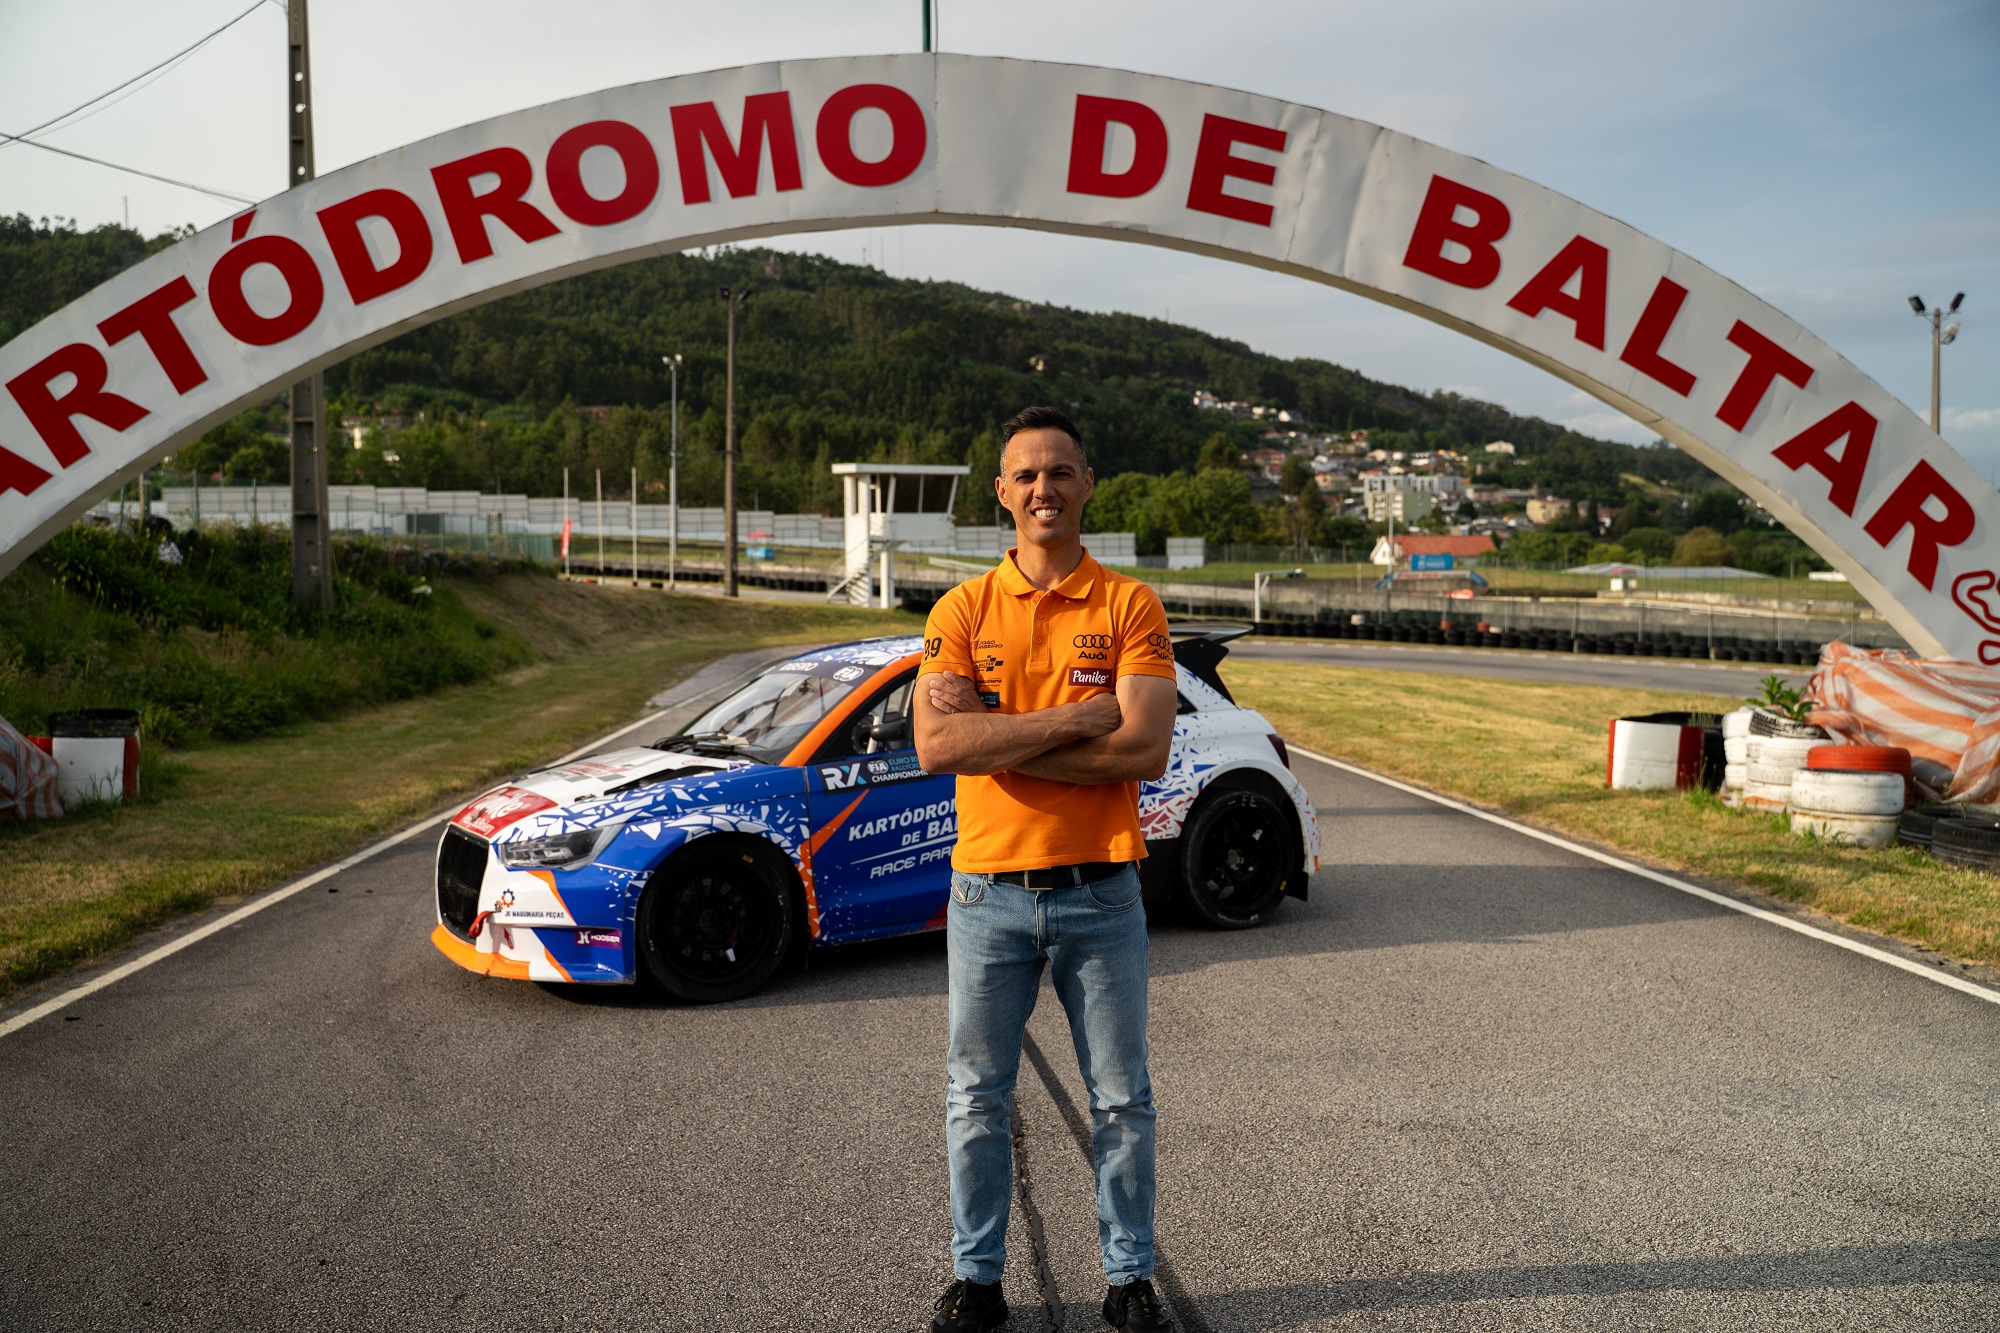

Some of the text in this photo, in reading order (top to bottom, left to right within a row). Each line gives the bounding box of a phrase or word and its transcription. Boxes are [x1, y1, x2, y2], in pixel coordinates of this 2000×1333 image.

[1067, 95, 1286, 226] DE
[1404, 176, 1970, 591] BALTAR
[1078, 651, 1107, 660] Audi
[867, 760, 888, 772] FIA
[888, 757, 910, 766] EURO
[891, 763, 920, 772] RALLYCRO
[821, 763, 867, 790] RX
[848, 798, 957, 841] KARTÓDRO
[901, 816, 958, 846] DE BA
[869, 845, 954, 879] RACE PAR
[545, 911, 565, 920] PEÇAS
